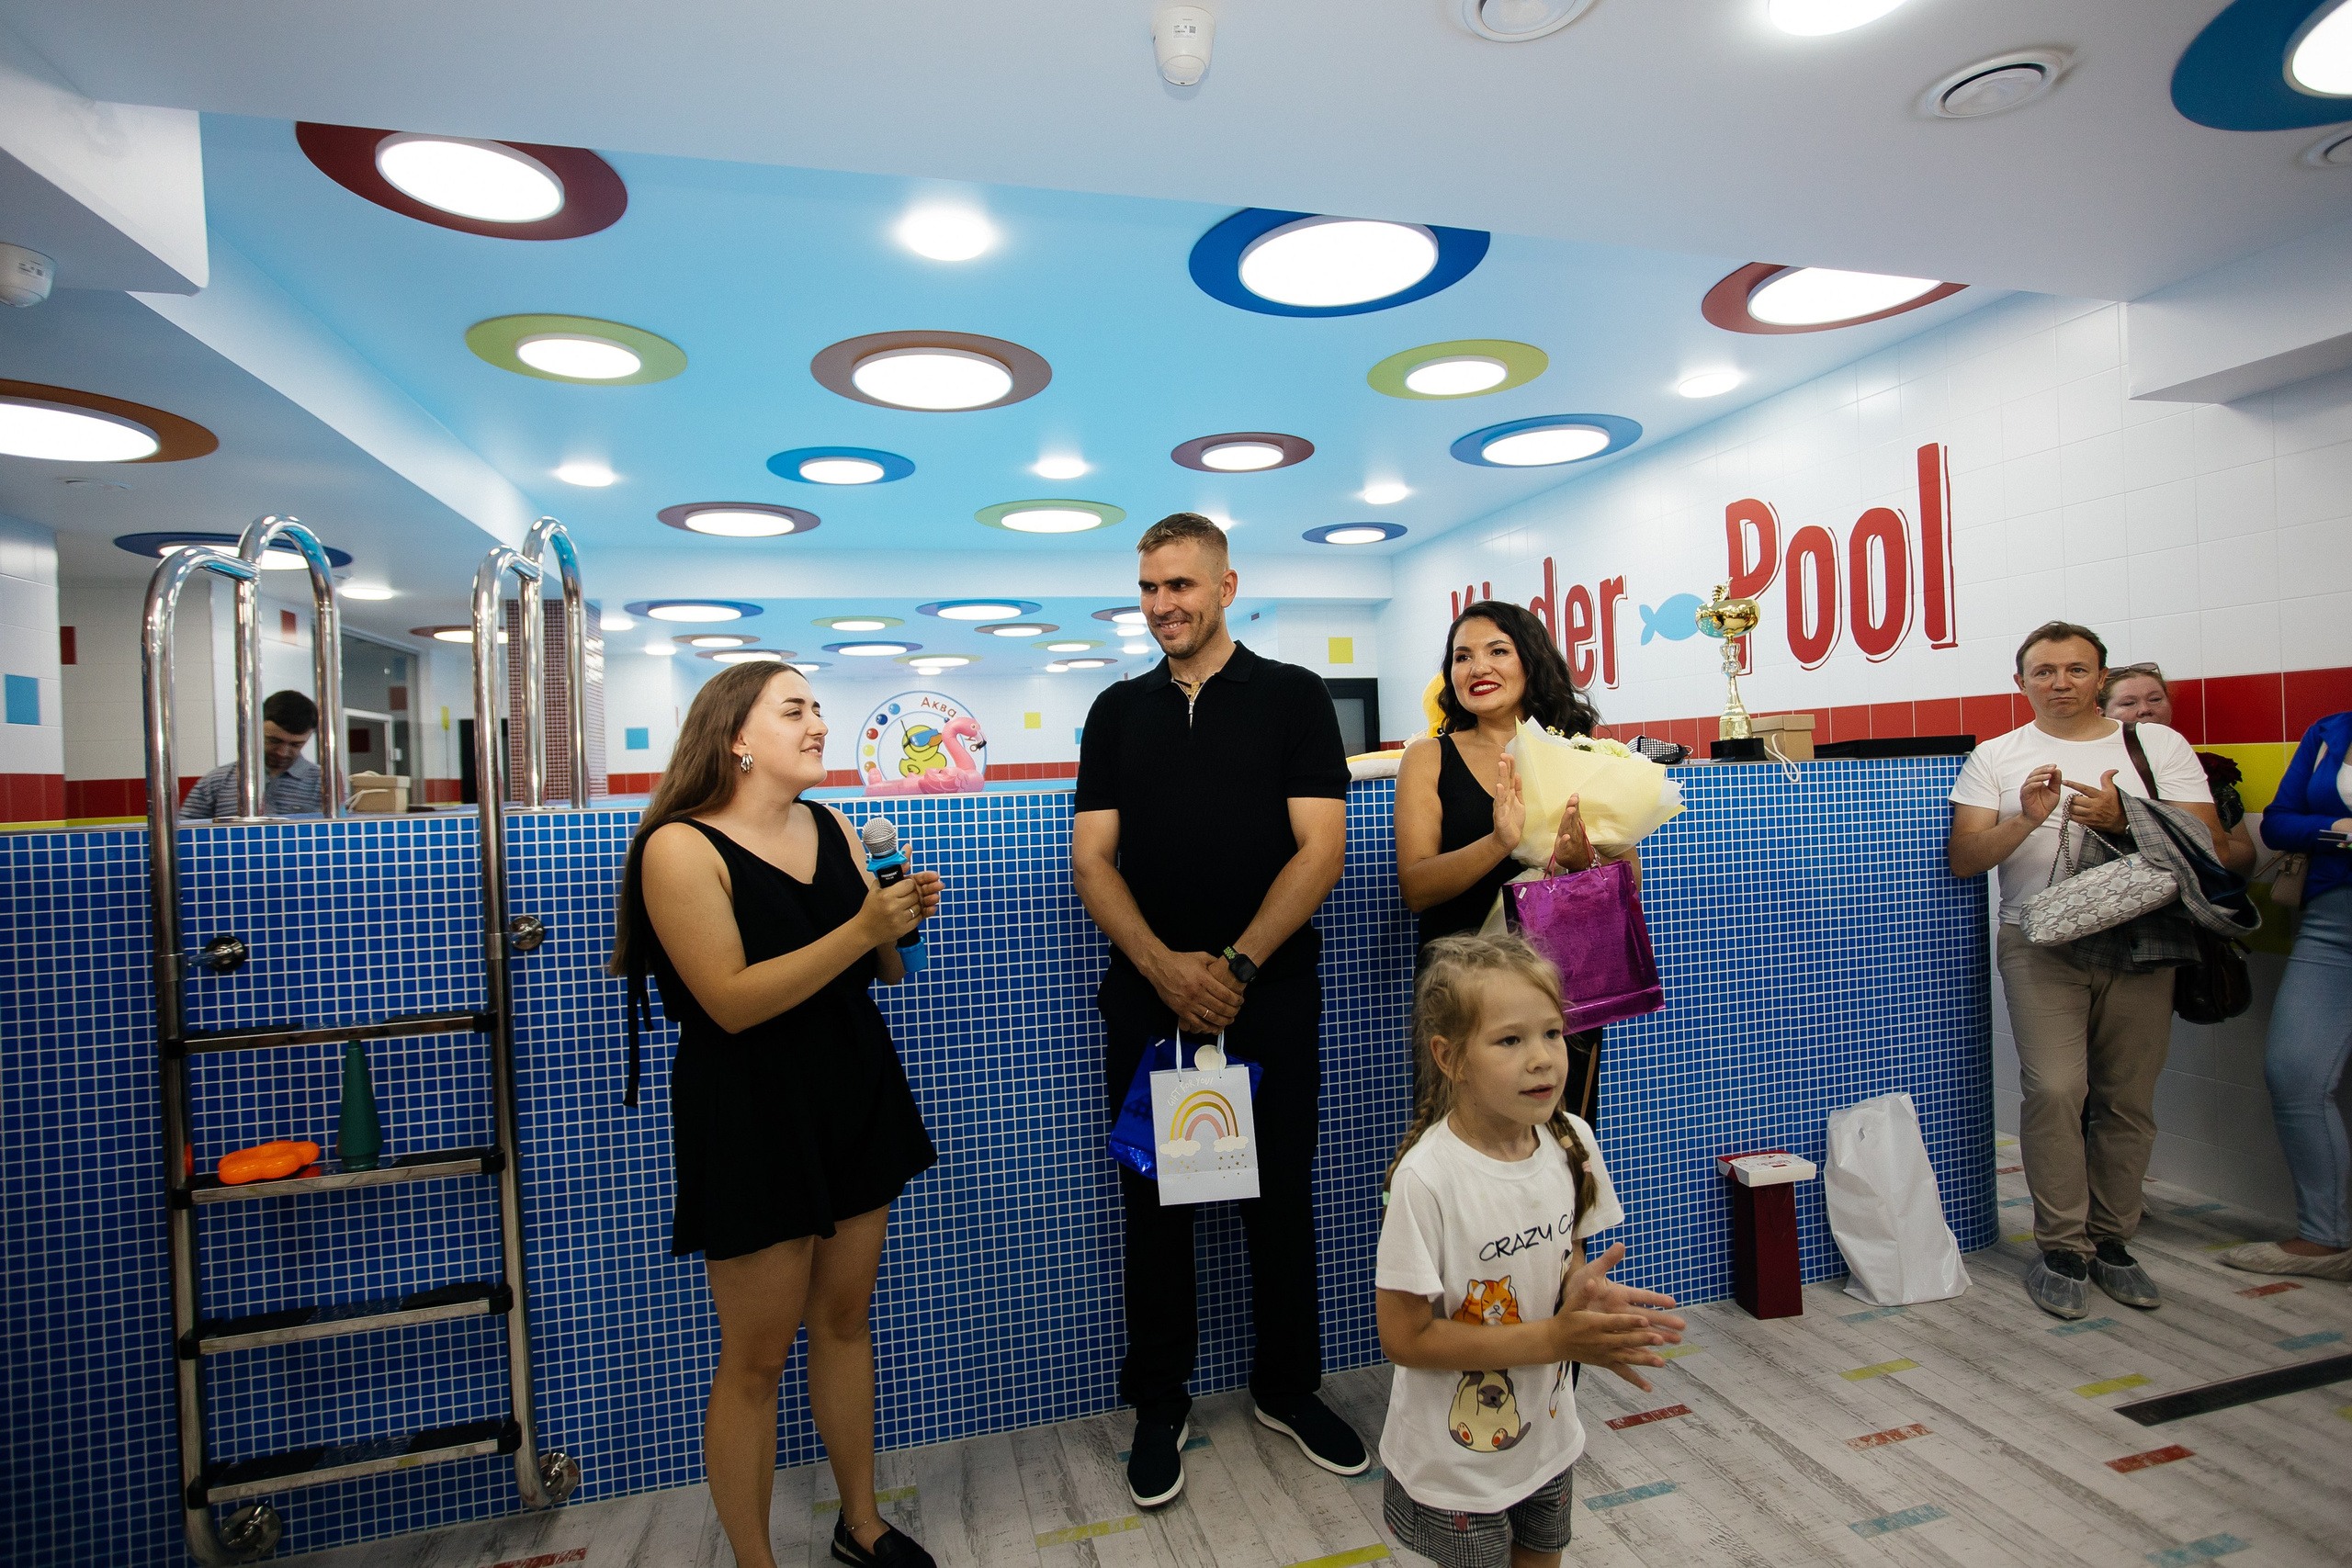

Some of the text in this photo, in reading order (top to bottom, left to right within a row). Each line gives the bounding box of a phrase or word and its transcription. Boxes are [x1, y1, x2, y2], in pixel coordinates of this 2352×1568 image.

[1725, 443, 1958, 677] Pool
[1180, 1079, 1195, 1092] FOR
[1479, 1209, 1574, 1261] CRAZY CA
